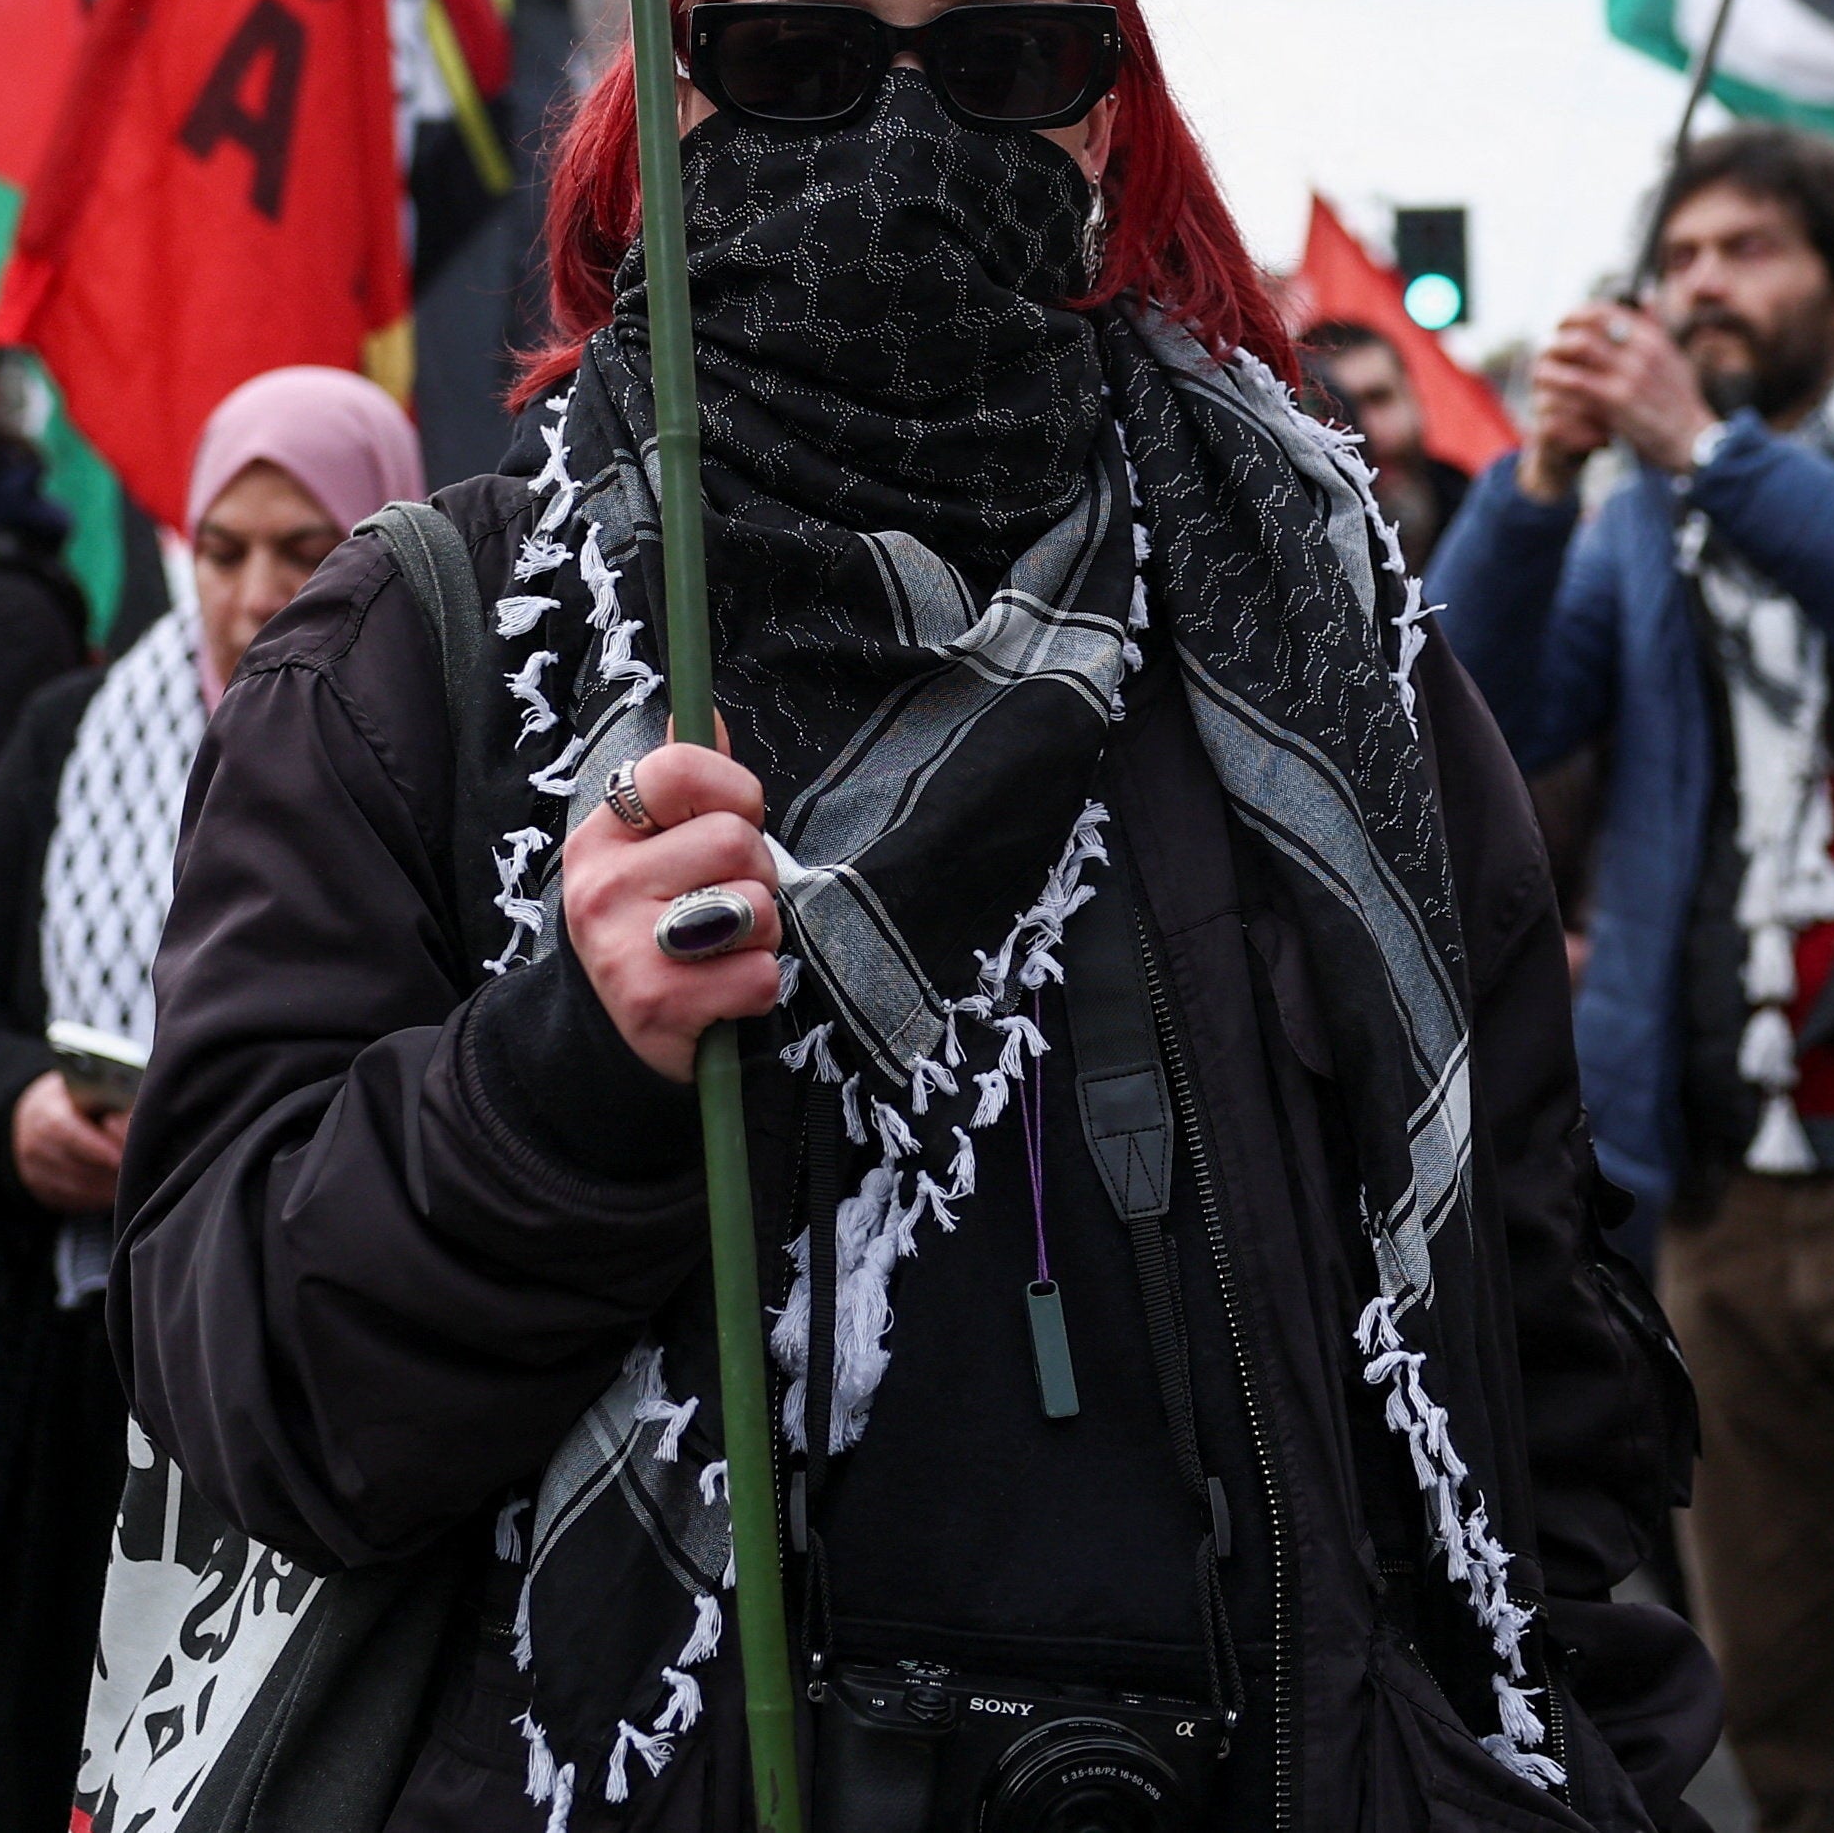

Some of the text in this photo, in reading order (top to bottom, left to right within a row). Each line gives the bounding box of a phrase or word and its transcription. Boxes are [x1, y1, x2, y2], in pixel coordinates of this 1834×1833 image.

[969, 1697, 1035, 1717] SONY
[1061, 1774, 1069, 1784] E
[1120, 1769, 1144, 1786] 16-50
[1144, 1783, 1161, 1800] OSS
